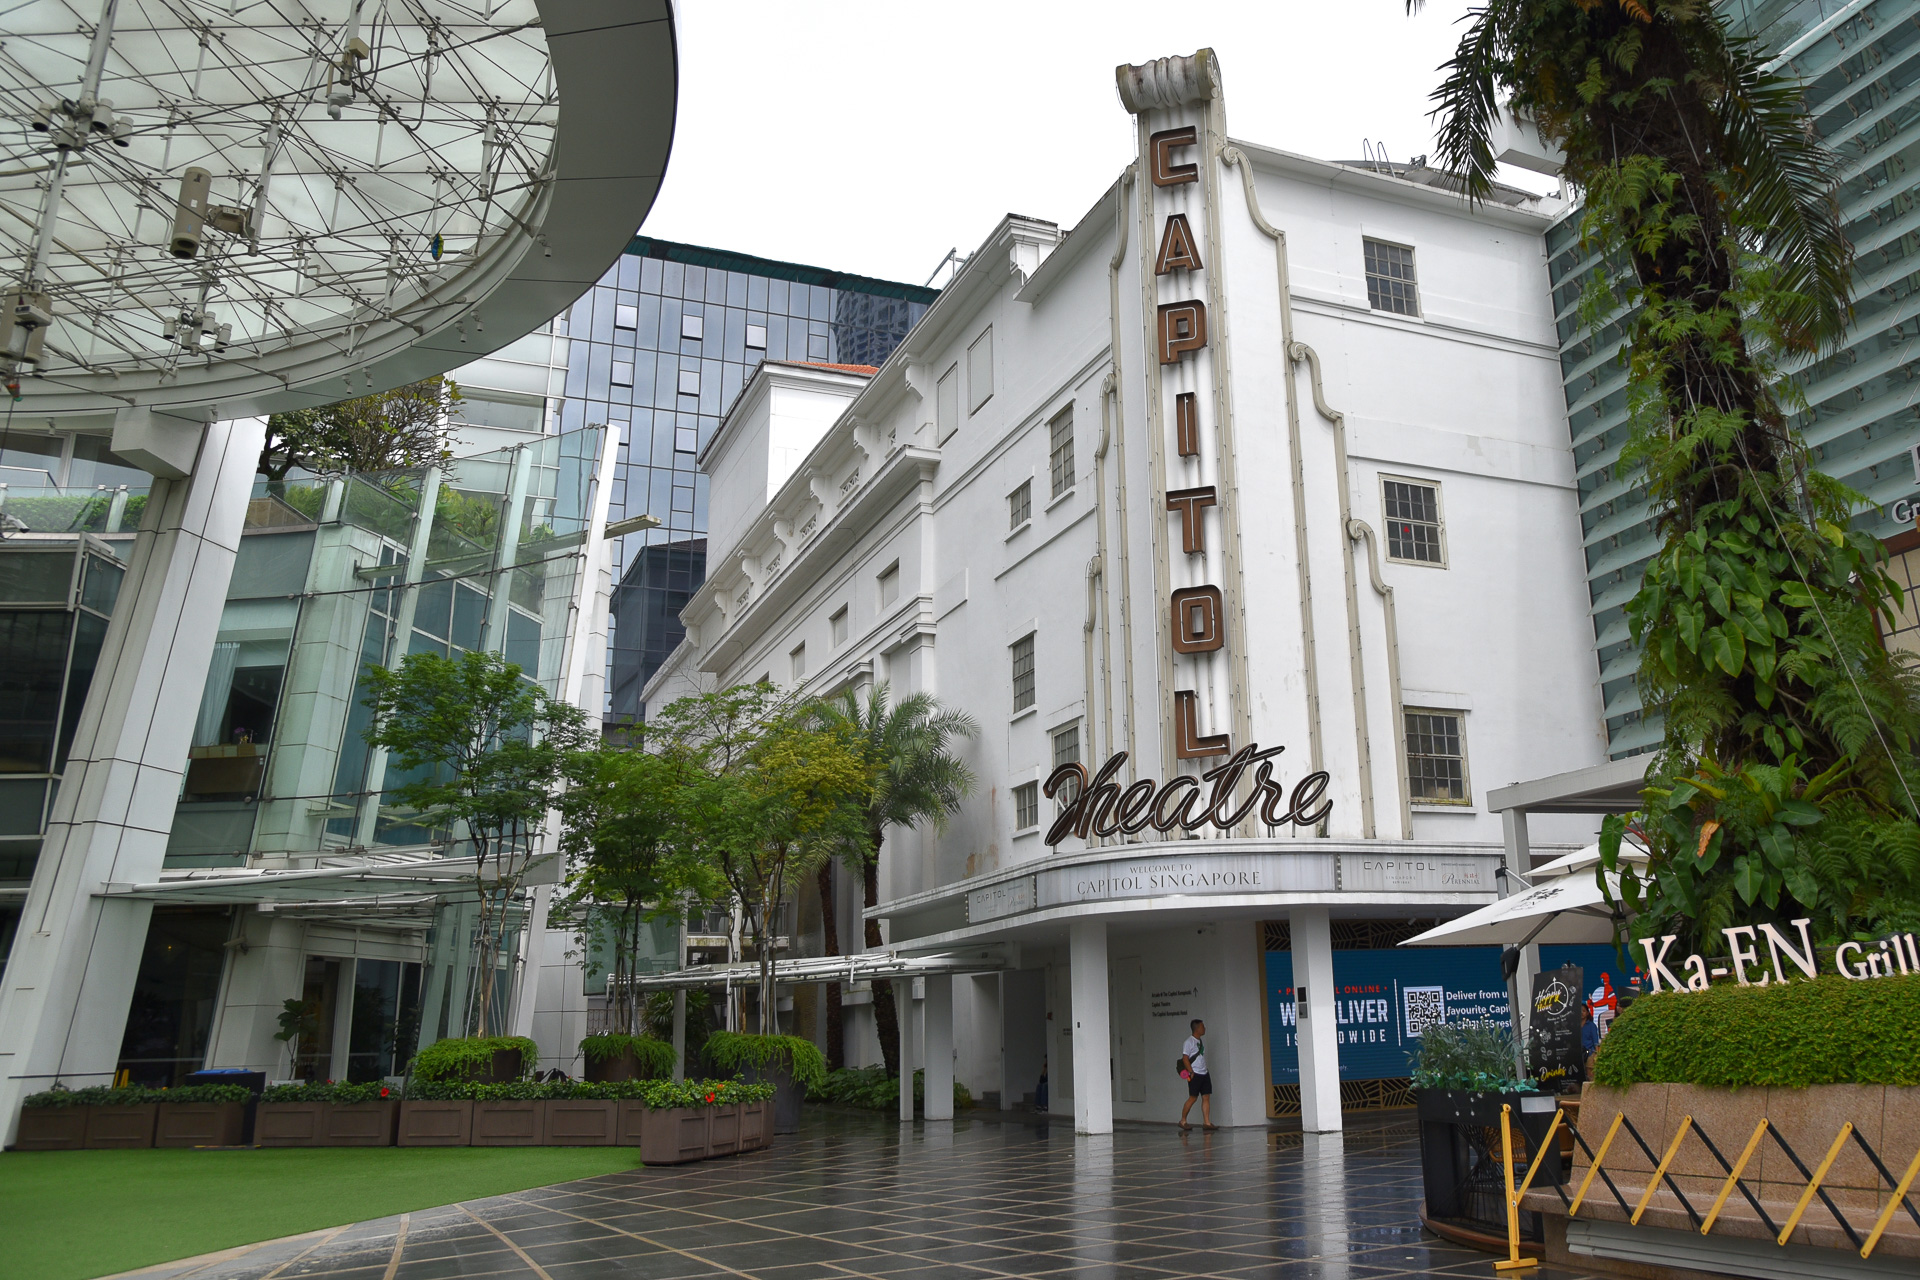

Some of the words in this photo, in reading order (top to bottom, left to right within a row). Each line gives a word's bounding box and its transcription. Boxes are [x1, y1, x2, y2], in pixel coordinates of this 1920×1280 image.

[1150, 125, 1231, 760] CAPITOL
[1043, 743, 1334, 846] Theatre
[1129, 864, 1176, 874] WELCOME
[1179, 863, 1192, 871] TO
[1363, 861, 1436, 871] CAPITOL
[1077, 876, 1143, 895] CAPITOL
[1150, 871, 1262, 889] SINGAPORE
[976, 890, 1006, 904] CAPITOL
[1639, 918, 1818, 995] Ka-EN
[1835, 933, 1920, 980] Grill
[1344, 985, 1380, 994] ONLINE
[1446, 990, 1477, 1000] Deliver
[1479, 989, 1500, 999] from
[1534, 988, 1562, 1007] Happy
[1447, 1004, 1487, 1015] favourite
[1536, 1003, 1552, 1013] Hour
[1539, 1063, 1567, 1082] Drinks
